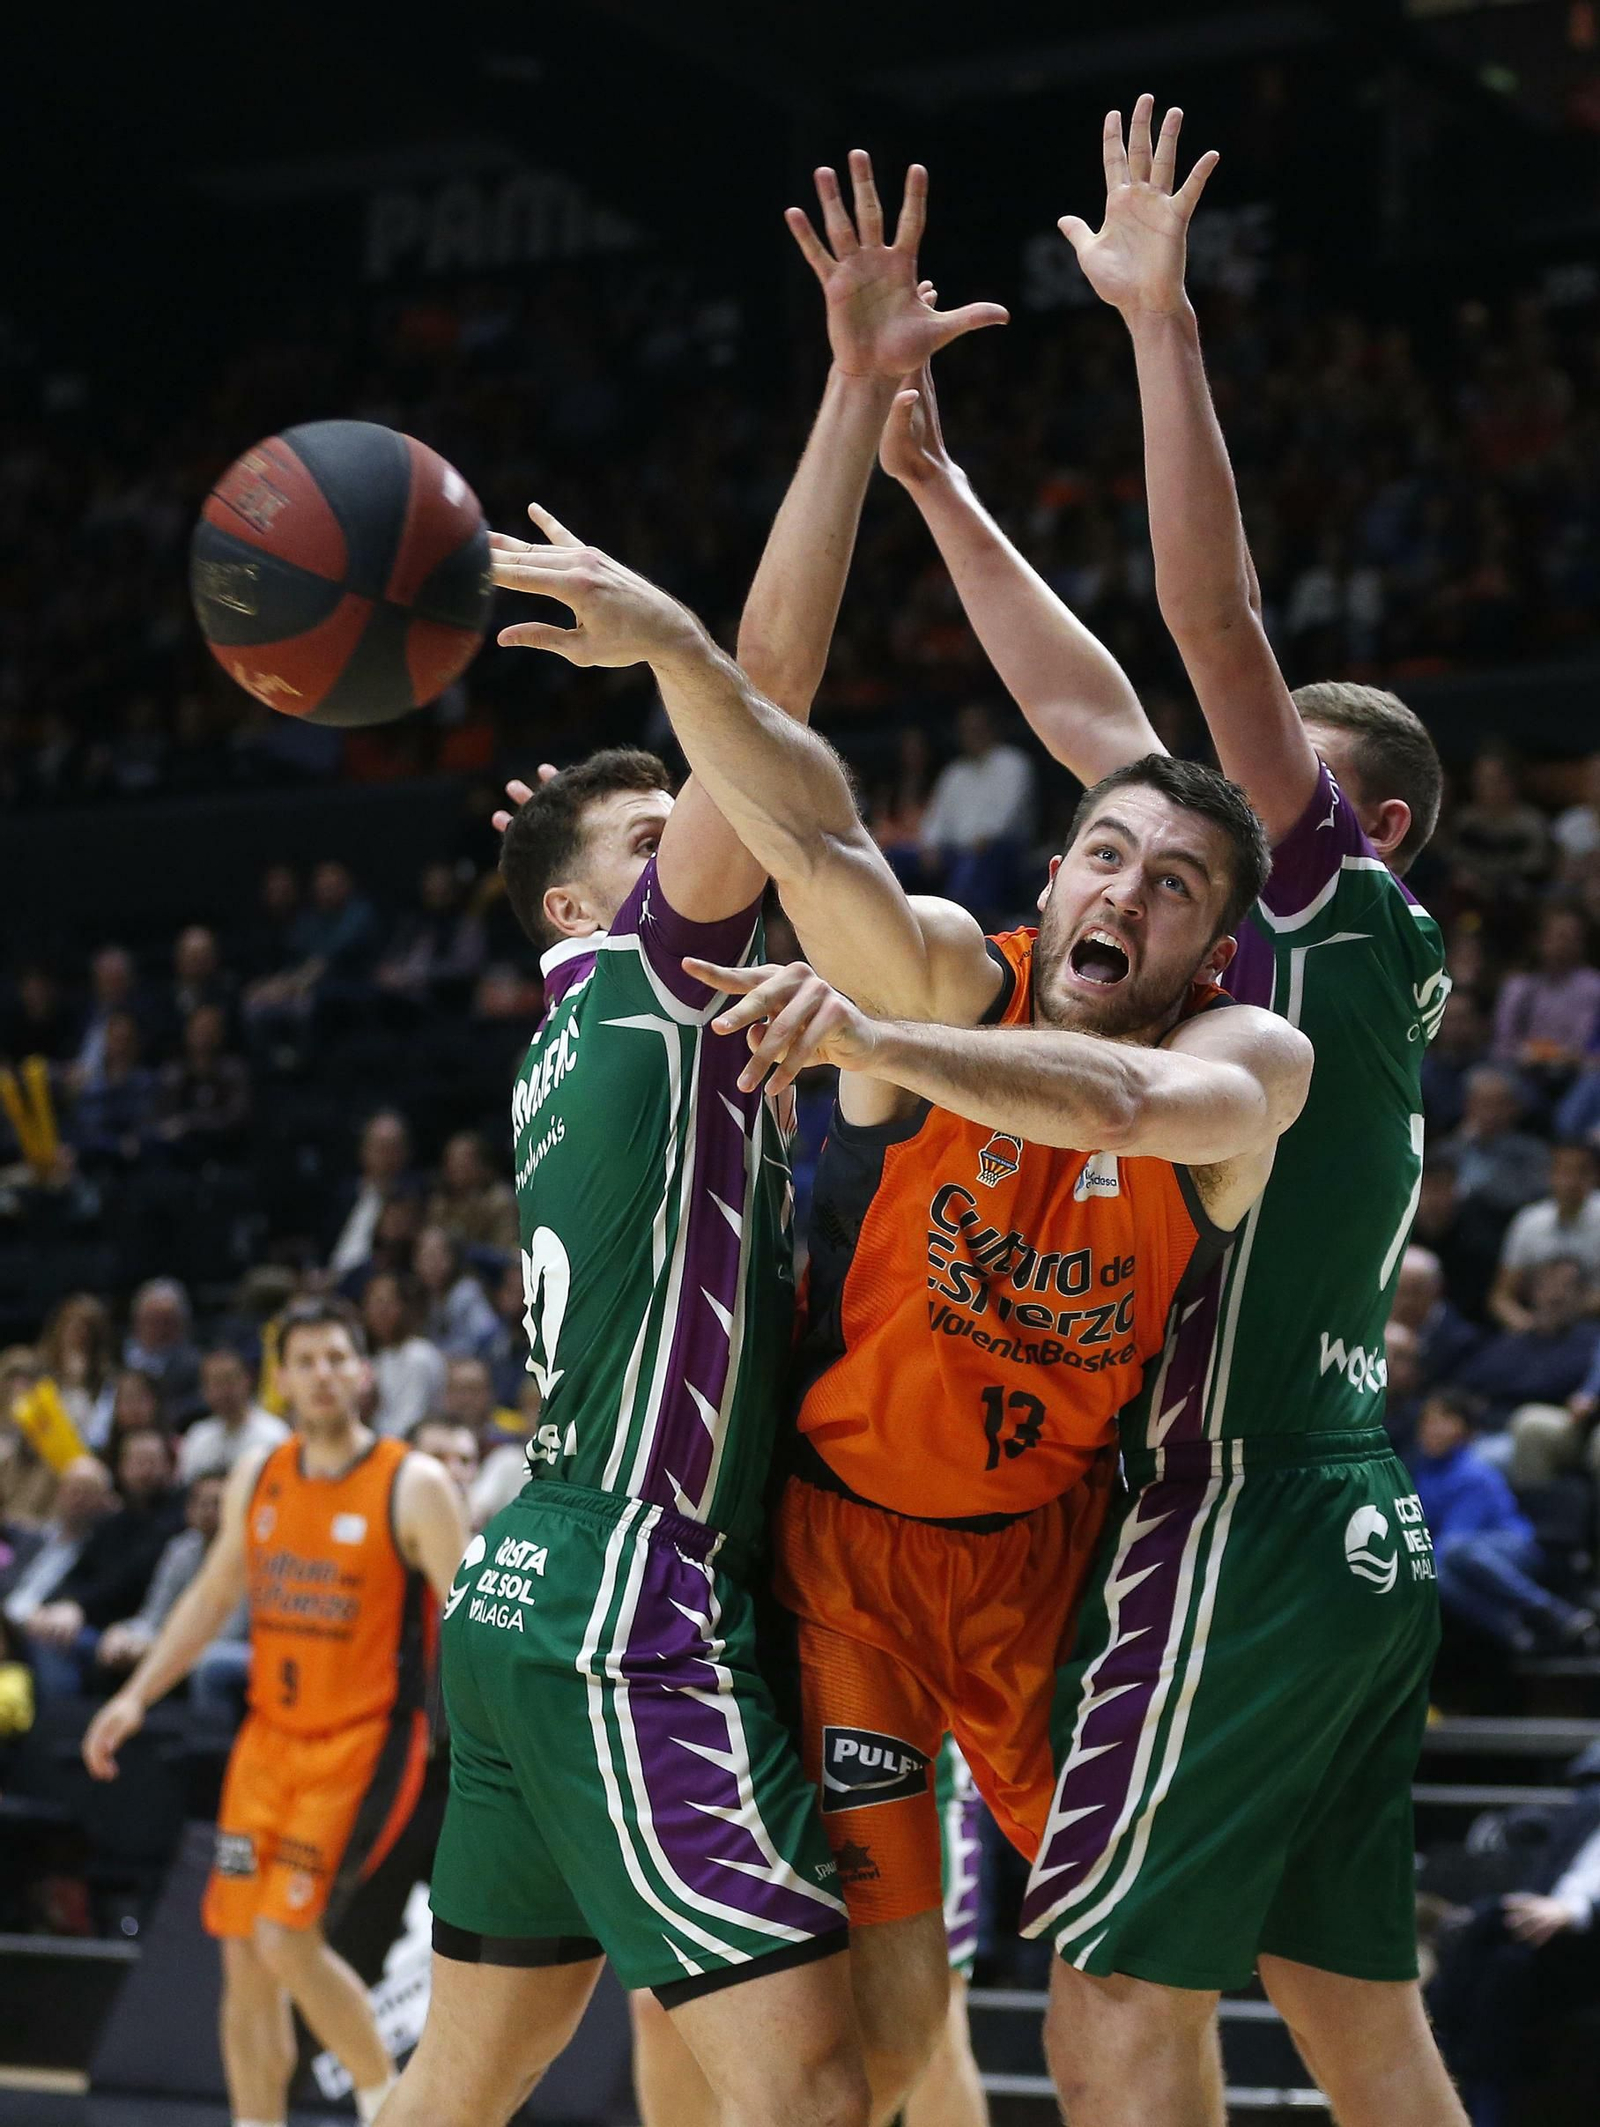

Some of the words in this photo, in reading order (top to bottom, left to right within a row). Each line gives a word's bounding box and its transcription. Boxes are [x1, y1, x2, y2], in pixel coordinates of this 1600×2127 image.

[1101, 1255, 1135, 1287] de
[981, 1385, 1046, 1471] 13
[476, 1569, 500, 1595] DL
[497, 1573, 536, 1606] SOL
